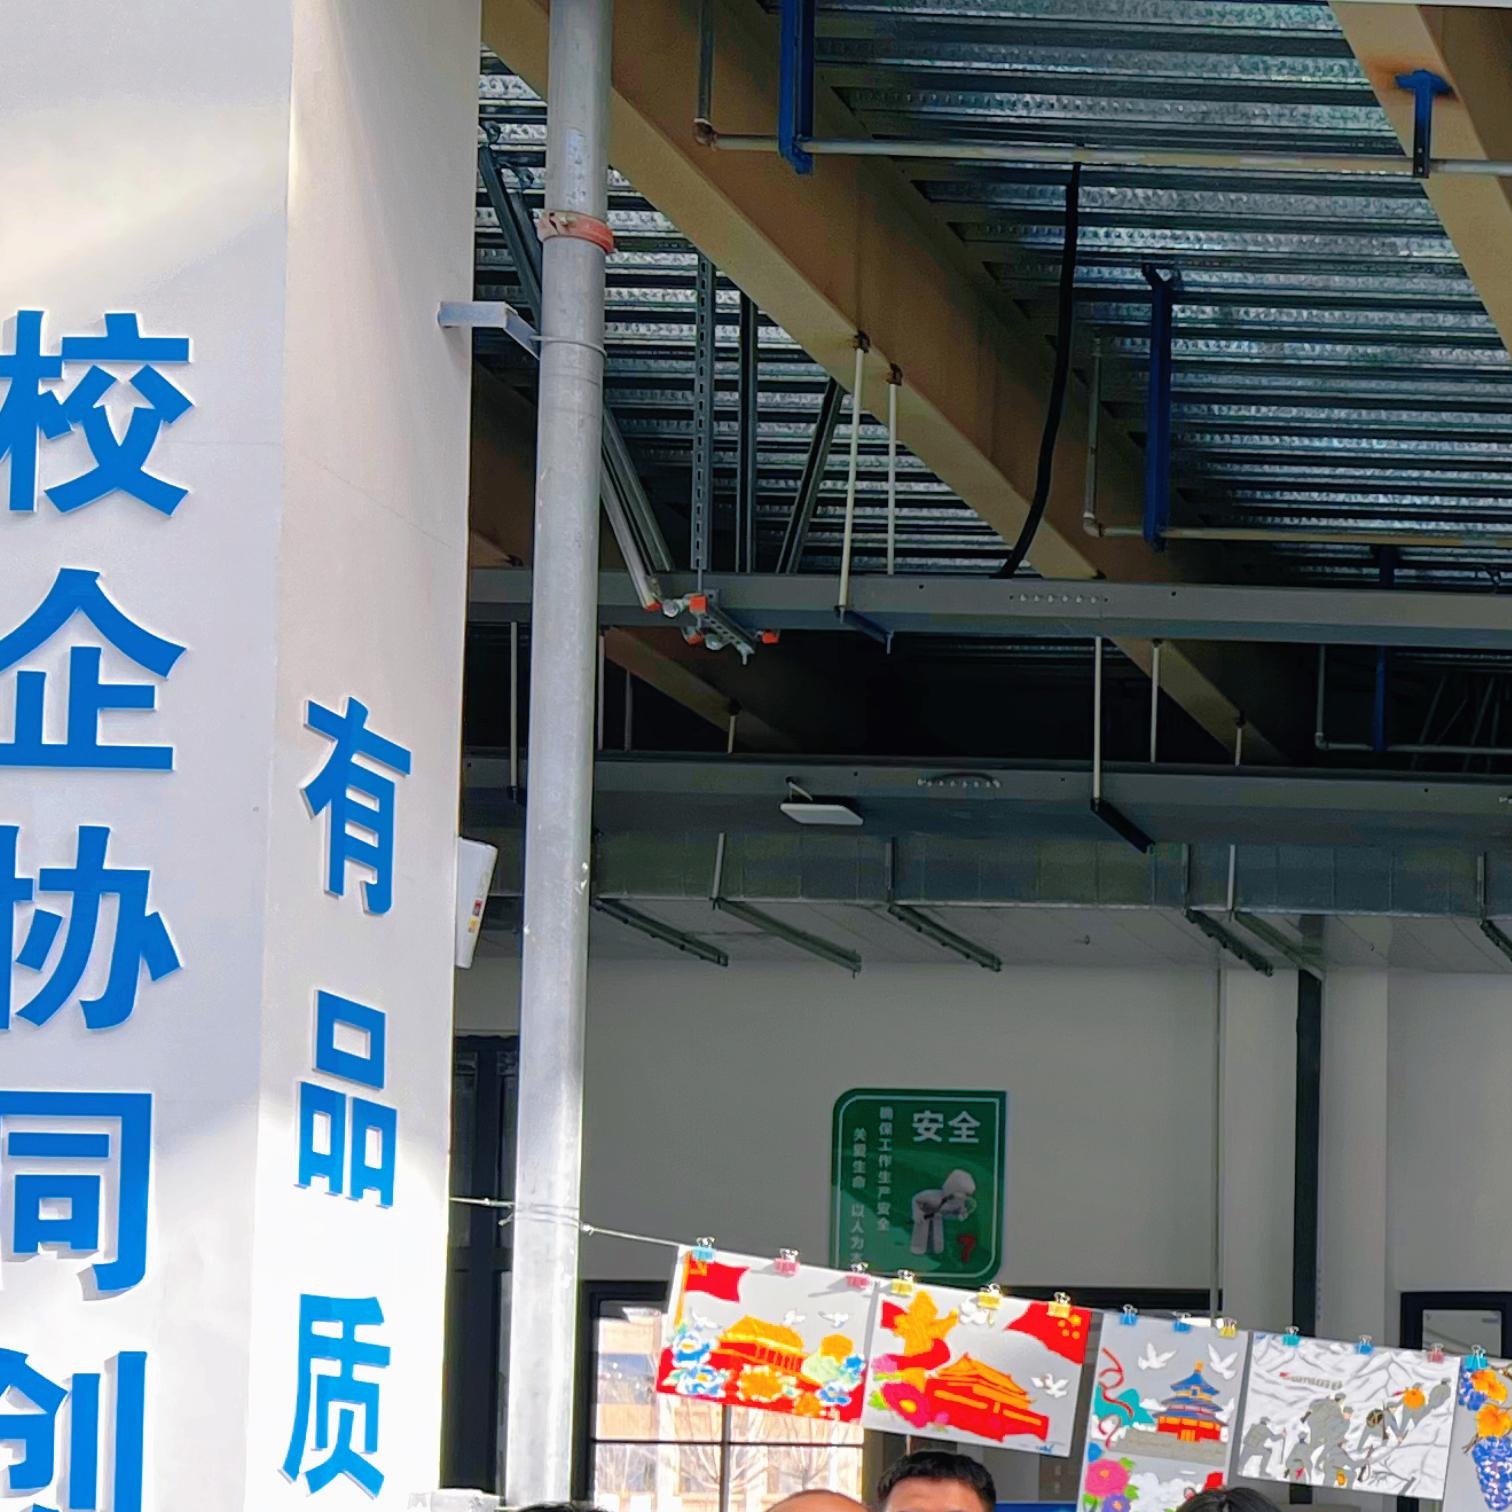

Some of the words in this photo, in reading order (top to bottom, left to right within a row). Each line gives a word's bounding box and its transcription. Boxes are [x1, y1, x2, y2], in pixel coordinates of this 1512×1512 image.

[281, 697, 411, 1500] 有品质
[912, 1110, 981, 1144] 安全
